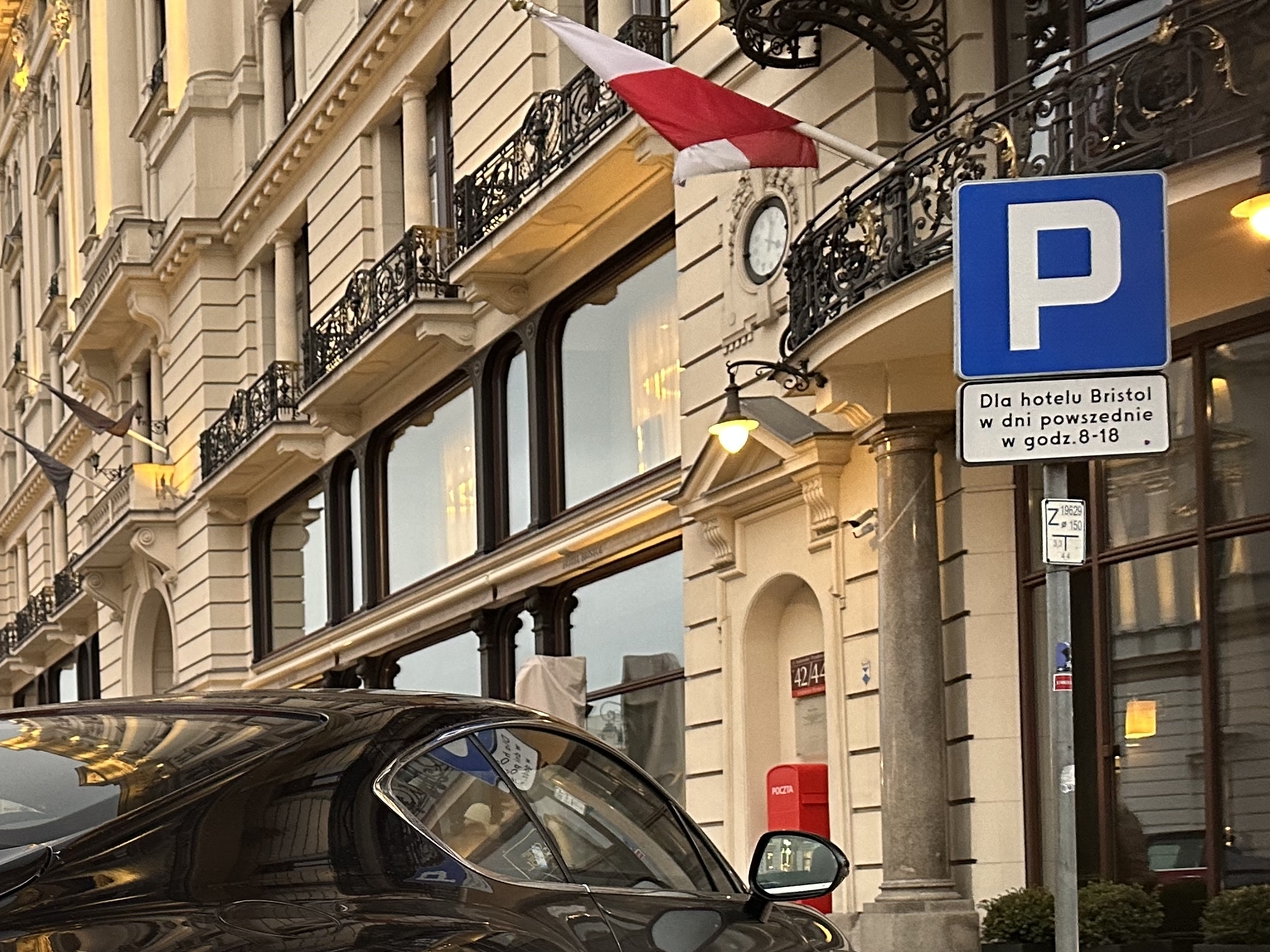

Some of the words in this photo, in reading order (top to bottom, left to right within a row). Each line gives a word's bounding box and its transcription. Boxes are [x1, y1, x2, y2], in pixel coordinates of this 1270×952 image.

[1008, 199, 1121, 351] P
[980, 393, 1012, 409] Dla
[1021, 390, 1082, 407] hotelu
[1091, 386, 1152, 403] Bristol
[980, 417, 993, 429] w
[1002, 412, 1031, 428] dni
[1041, 407, 1154, 430] powszednie
[1002, 437, 1015, 448] w
[1069, 519, 1082, 531] 150
[771, 785, 793, 795] POCZTA
